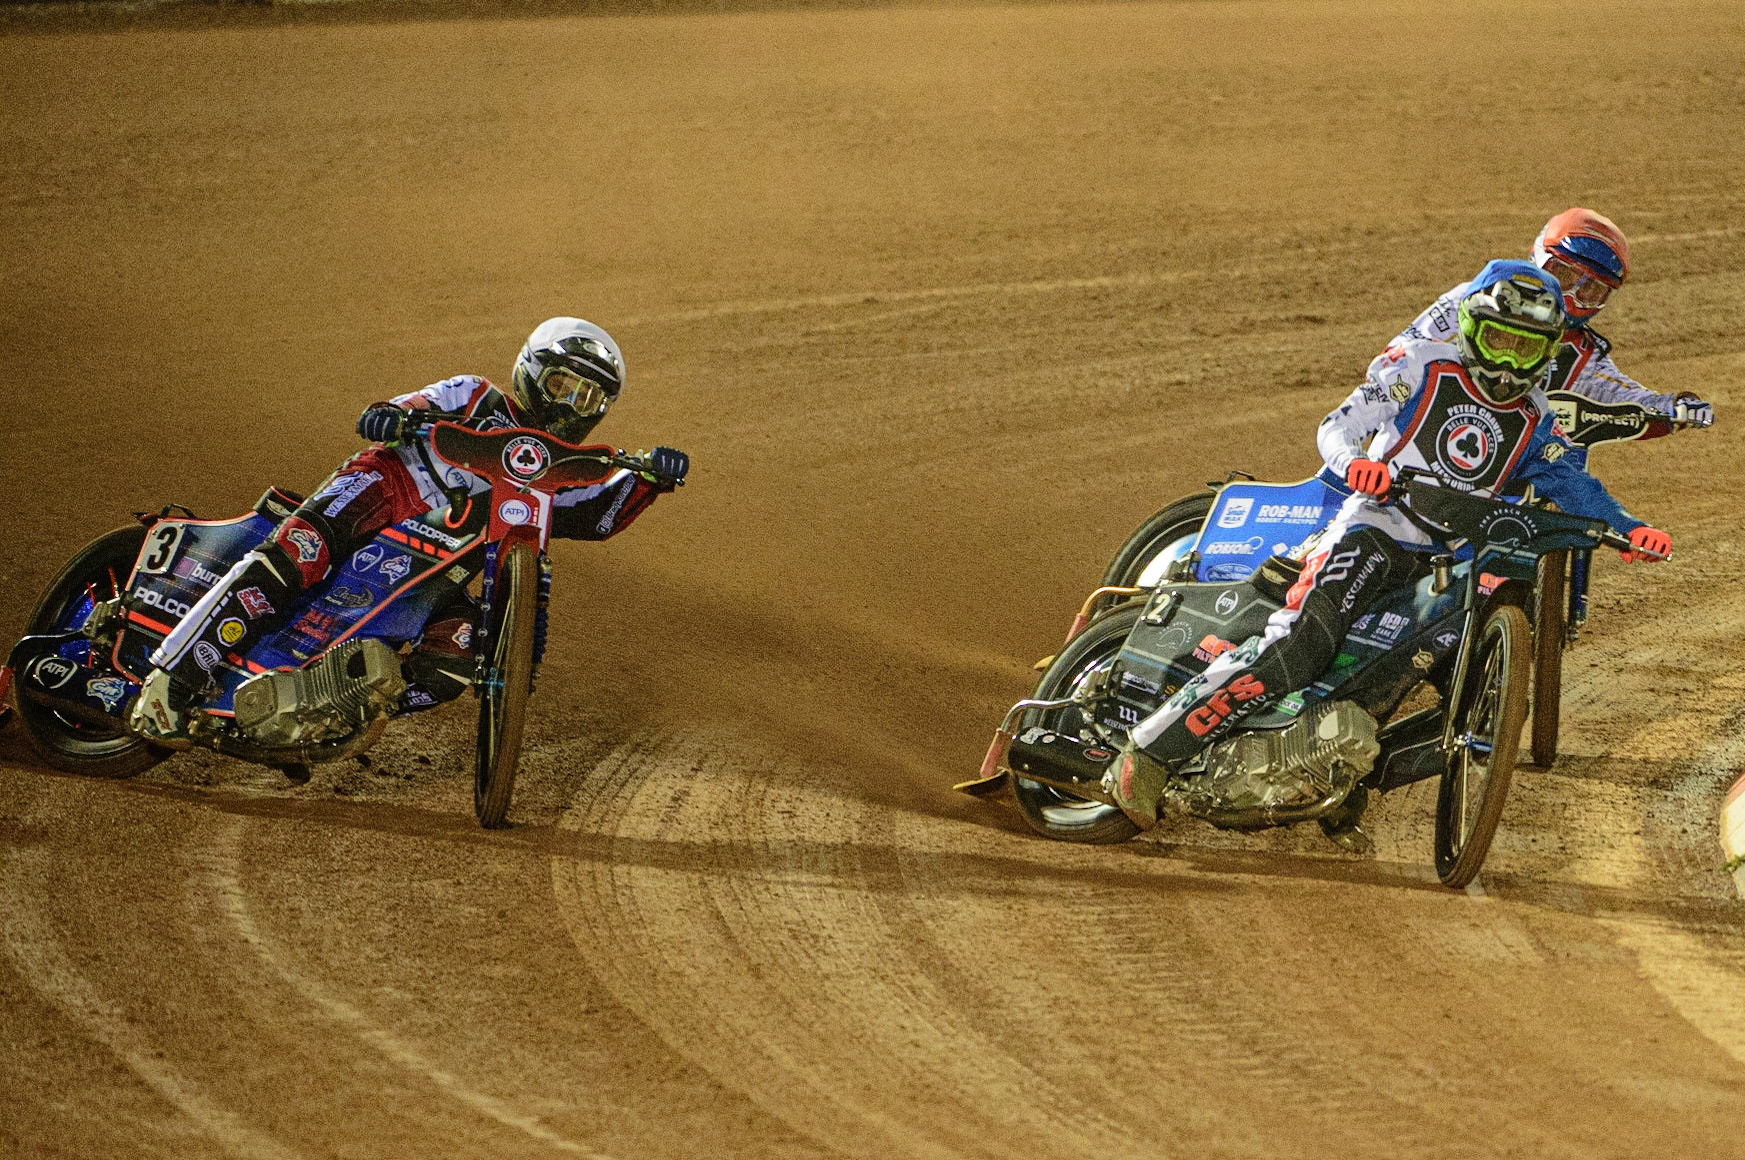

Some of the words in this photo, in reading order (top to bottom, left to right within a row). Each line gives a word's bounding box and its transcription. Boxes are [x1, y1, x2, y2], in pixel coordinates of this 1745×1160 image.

[1446, 417, 1469, 432] BELLE
[1472, 418, 1487, 432] VUE
[1485, 432, 1494, 453] ACES
[1447, 404, 1477, 417] PETER
[1479, 407, 1505, 443] CRAVEN
[452, 471, 467, 486] ATP
[505, 507, 525, 516] ATPI
[1258, 504, 1323, 519] ROB-MAN
[1493, 508, 1521, 516] BEACH
[147, 526, 178, 570] 3
[401, 519, 461, 548] POLCOPPER
[133, 586, 191, 619] POLCO
[1146, 593, 1171, 620] 2
[42, 662, 70, 677] ATPI
[1185, 673, 1265, 737] CFS
[1202, 693, 1275, 742] ILTRATIO
